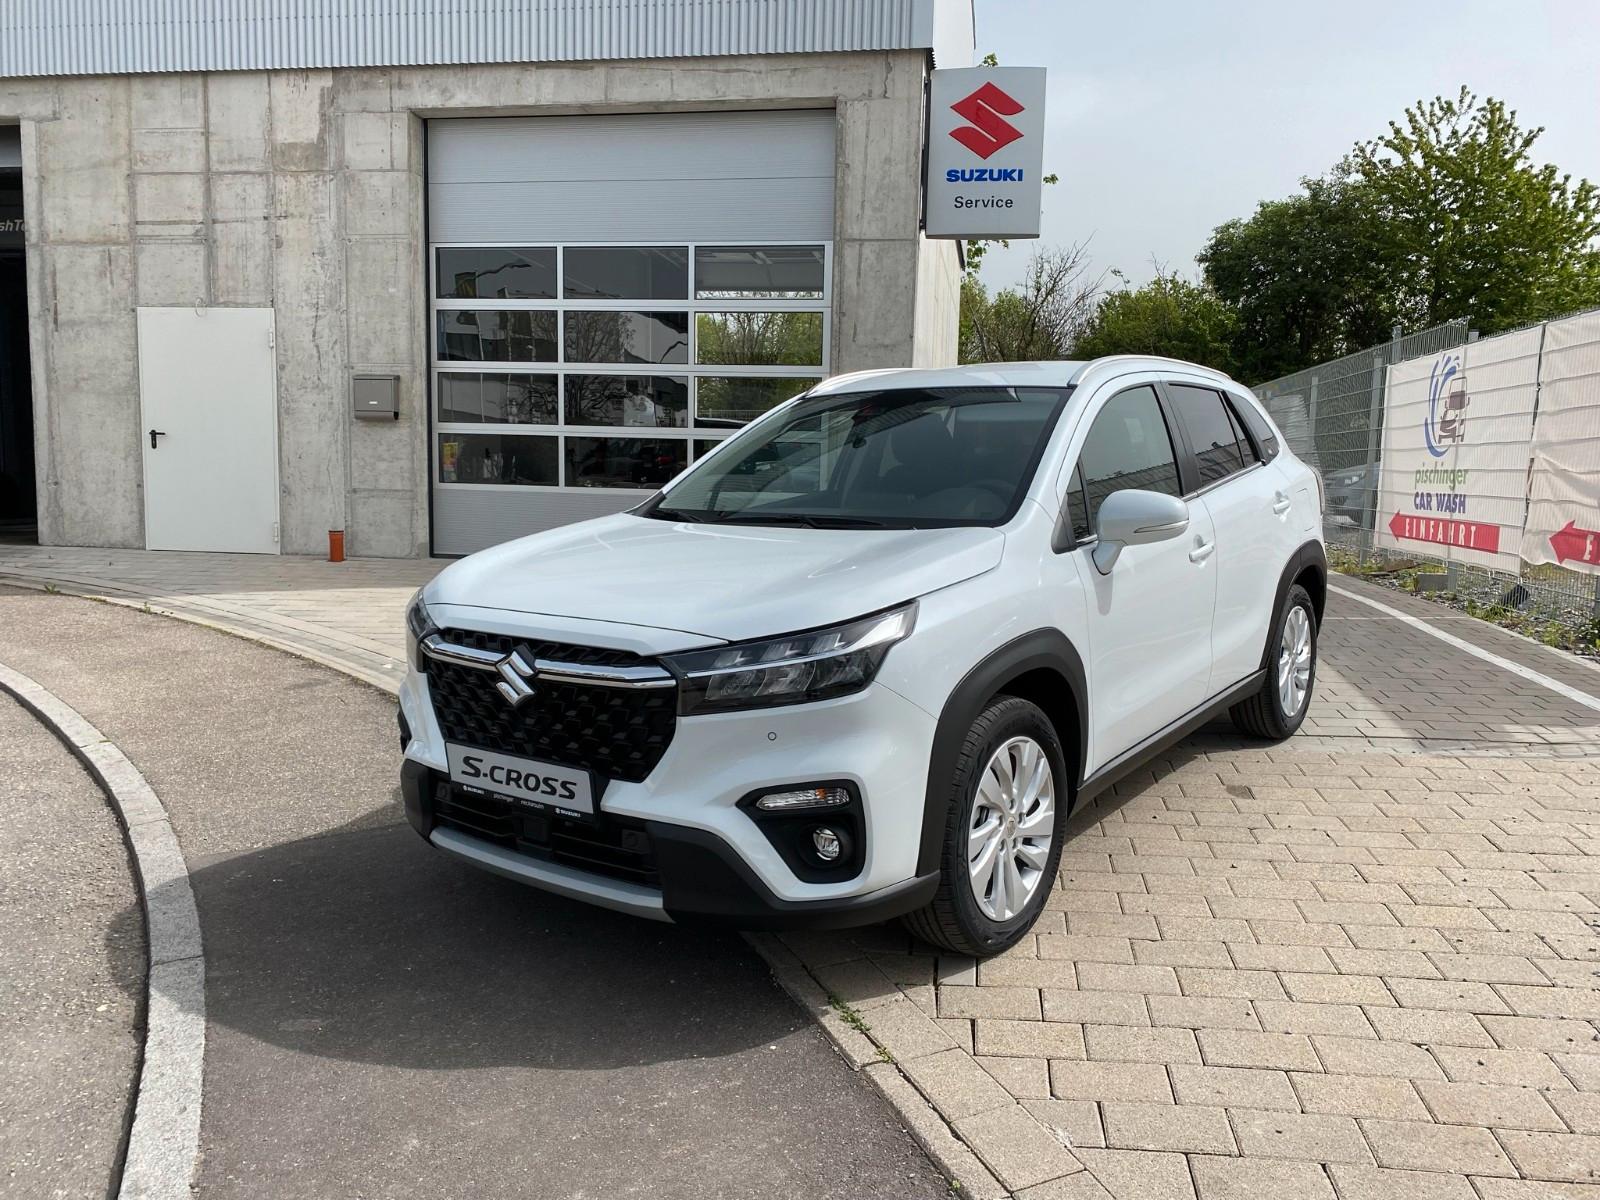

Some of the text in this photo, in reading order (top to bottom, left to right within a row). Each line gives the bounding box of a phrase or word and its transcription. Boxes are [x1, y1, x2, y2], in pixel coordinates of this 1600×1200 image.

[946, 168, 1023, 182] SUZUKI
[954, 196, 1014, 209] Service
[1414, 461, 1468, 490] pischinger
[1413, 492, 1466, 514] CAR WASH
[1405, 518, 1476, 547] EINFAHRT
